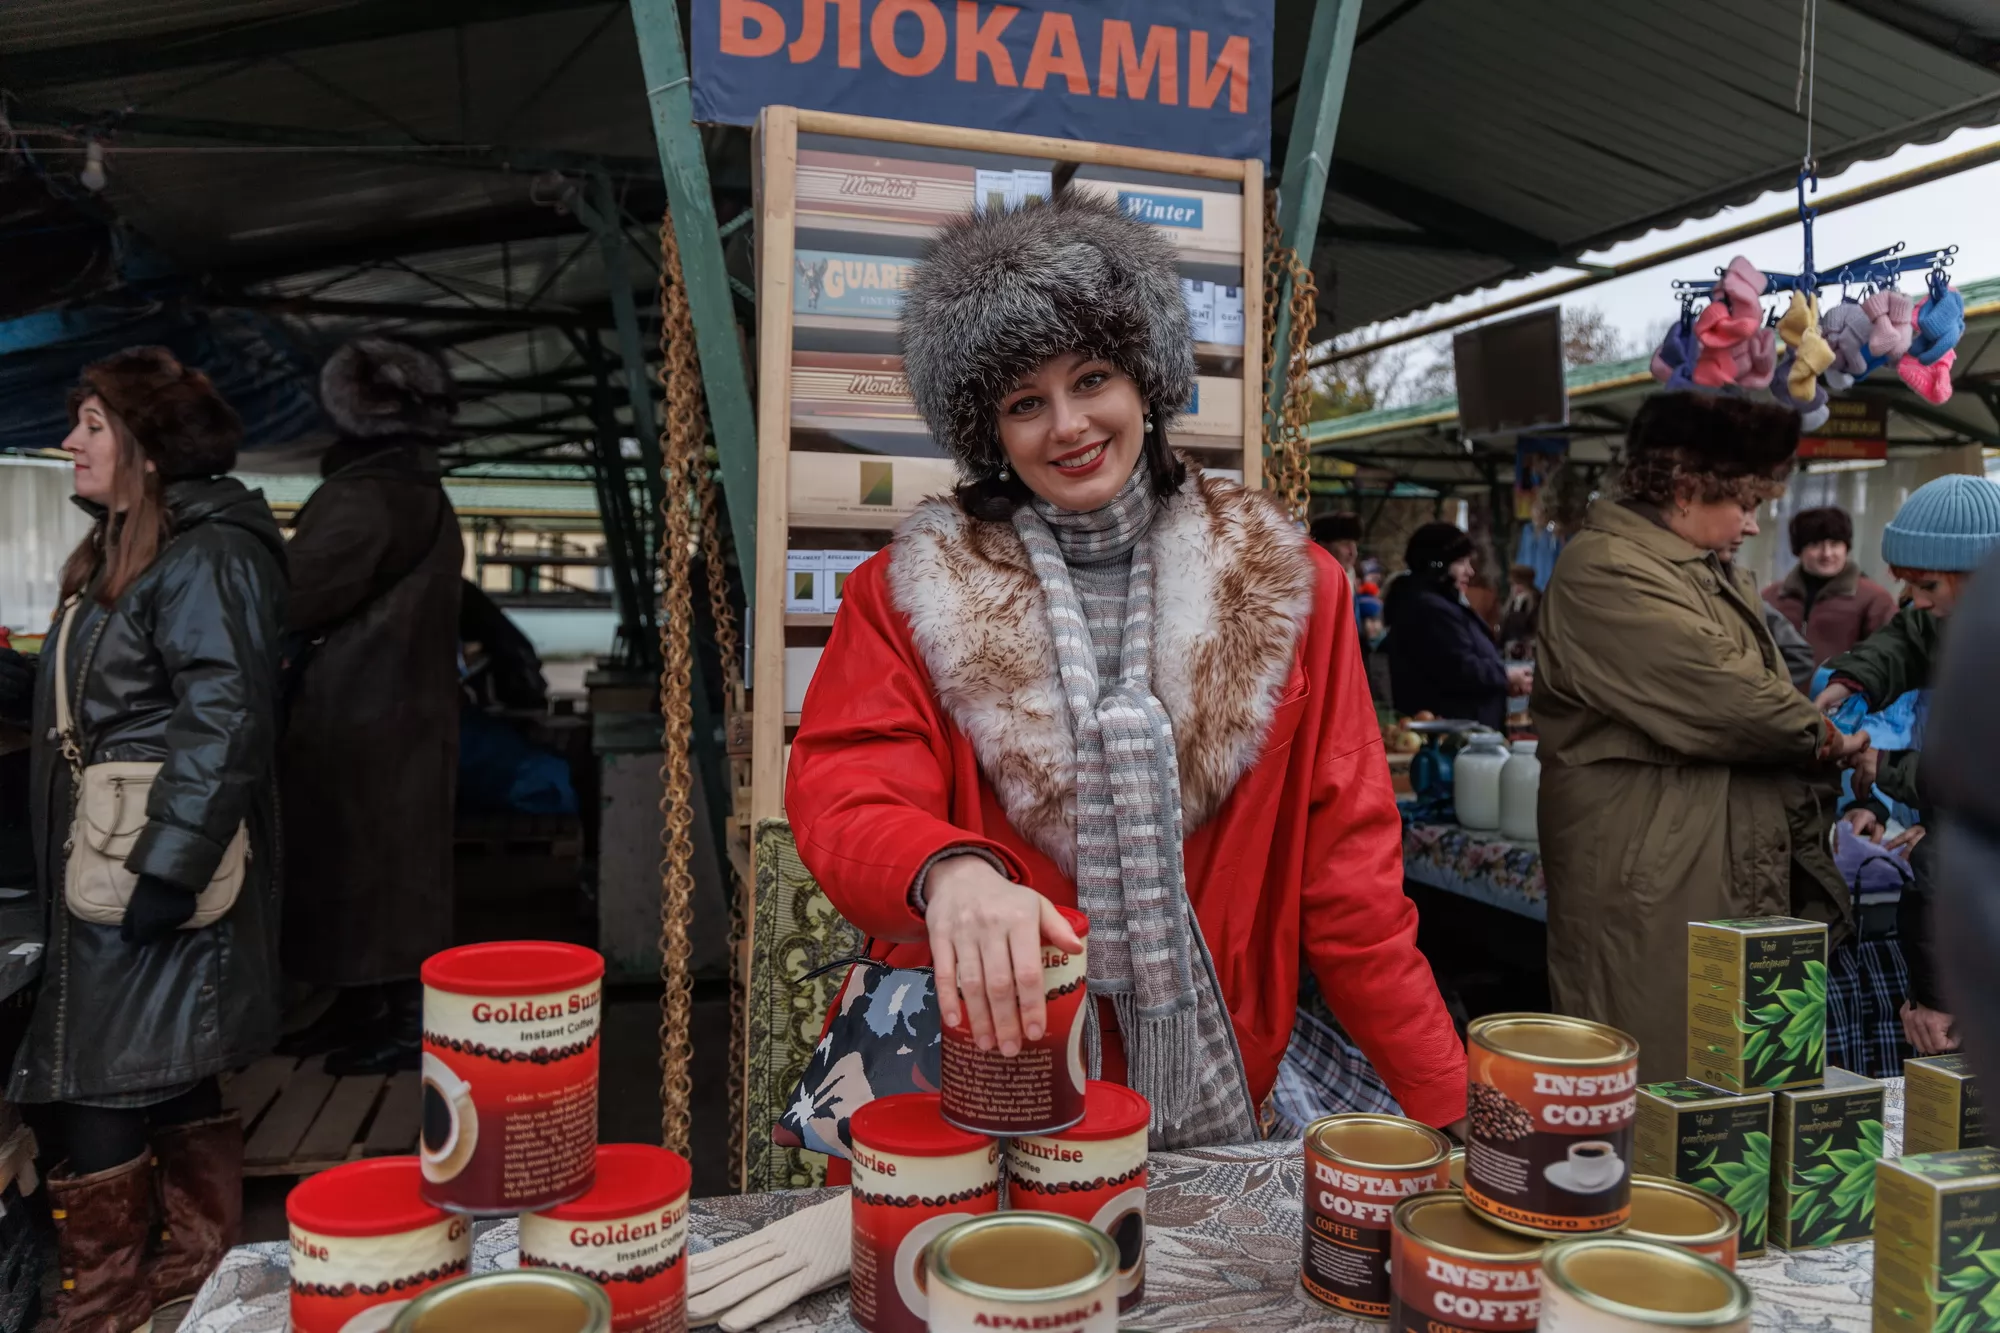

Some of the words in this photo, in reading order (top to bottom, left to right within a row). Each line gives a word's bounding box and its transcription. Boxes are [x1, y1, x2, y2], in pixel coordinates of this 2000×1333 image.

[719, 0, 1250, 114] БЛОКАМИ
[840, 174, 916, 199] Monkini
[1127, 197, 1196, 222] Winter
[1190, 309, 1210, 320] ENT
[1761, 941, 1777, 952] Чай
[472, 1001, 562, 1023] Golden
[520, 1026, 565, 1042] Instant
[991, 1096, 1014, 1105] brewed
[1038, 1096, 1052, 1104] Each
[1696, 1114, 1714, 1126] Чай
[1012, 1137, 1083, 1163] Sunrise
[1015, 1157, 1041, 1174] Coffee
[1315, 1160, 1437, 1196] INSTANT
[1319, 1190, 1394, 1222] COFF
[1497, 1207, 1579, 1228] БОДРОГО
[569, 1222, 657, 1247] Golden
[1316, 1216, 1359, 1240] COFFEE
[617, 1242, 659, 1263] Instant
[973, 1300, 1103, 1331] АРАБИКА
